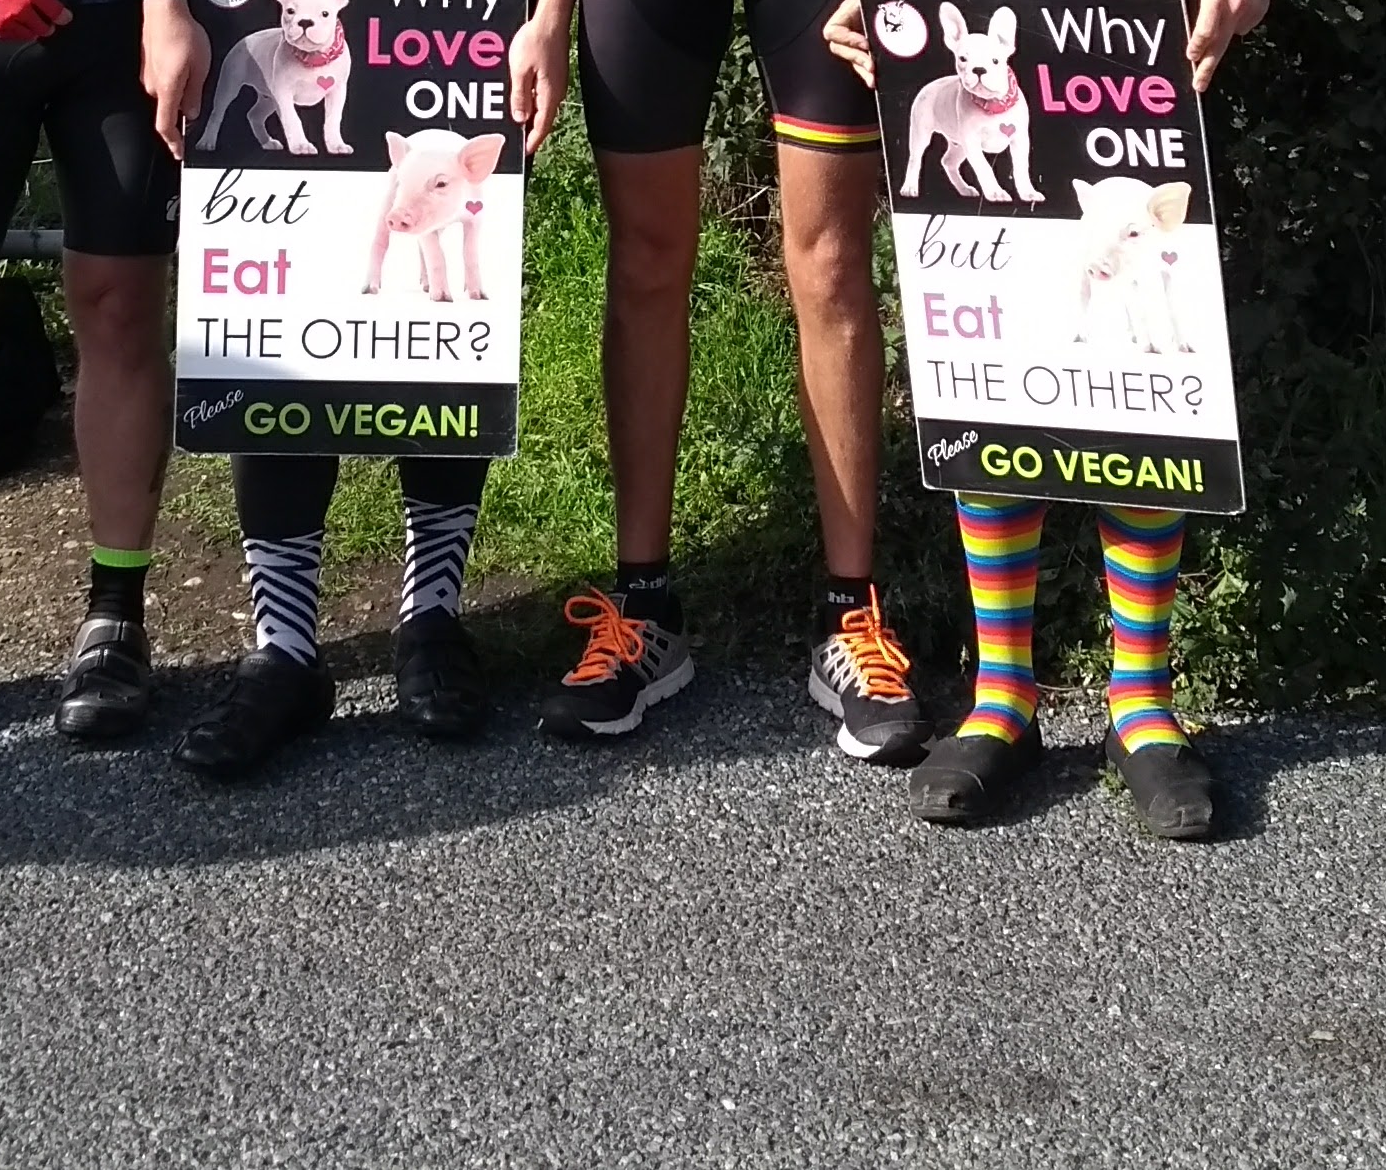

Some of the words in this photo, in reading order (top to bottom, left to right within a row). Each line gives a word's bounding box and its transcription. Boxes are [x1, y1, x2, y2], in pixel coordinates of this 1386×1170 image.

[368, 17, 504, 67] Love
[1041, 7, 1166, 65] Why
[406, 81, 504, 120] ONE
[1036, 65, 1177, 114] Love
[1085, 128, 1186, 168] ONE
[202, 168, 310, 225] but
[916, 214, 1012, 271] but
[203, 248, 291, 295] Eat
[197, 318, 282, 358] THE
[301, 318, 490, 361] OTHER?
[923, 292, 1003, 340] Eat
[183, 388, 245, 429] Please
[243, 402, 311, 436] GO
[324, 403, 478, 438] VEGAN!
[926, 360, 1007, 402] THE
[1023, 365, 1203, 416] OTHER?
[927, 428, 979, 467] Please
[980, 444, 1043, 479] GO
[1052, 449, 1204, 493] VEGAN!
